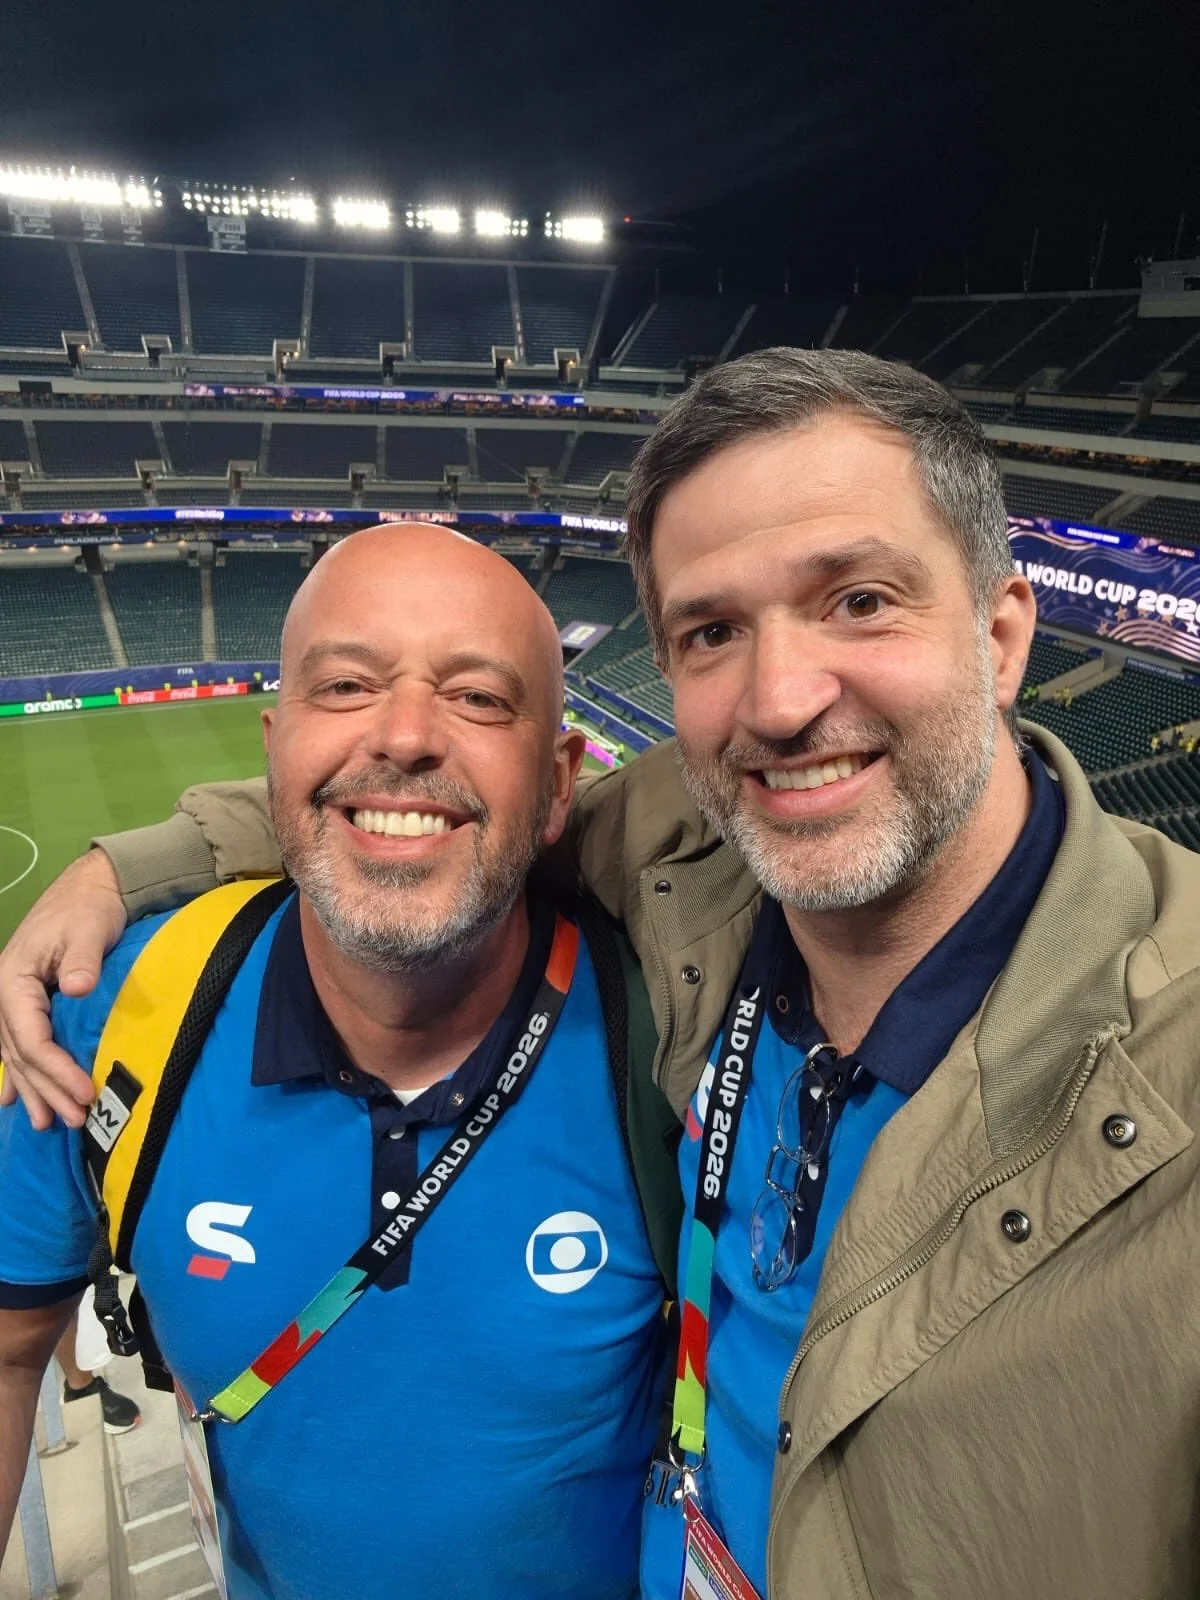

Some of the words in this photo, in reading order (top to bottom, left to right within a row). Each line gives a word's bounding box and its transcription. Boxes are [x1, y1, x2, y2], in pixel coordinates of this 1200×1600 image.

[561, 514, 582, 527] FIFA
[583, 517, 619, 531] WORLD
[1026, 562, 1094, 595] WORLD
[1094, 579, 1137, 605] CUP
[1136, 589, 1200, 622] 202
[719, 1055, 744, 1108] CUP
[372, 1214, 416, 1256] FIFA
[406, 1138, 471, 1212] WORLD
[466, 1094, 500, 1136] CUP
[497, 1013, 548, 1094] 2026
[704, 1109, 732, 1199] 2026
